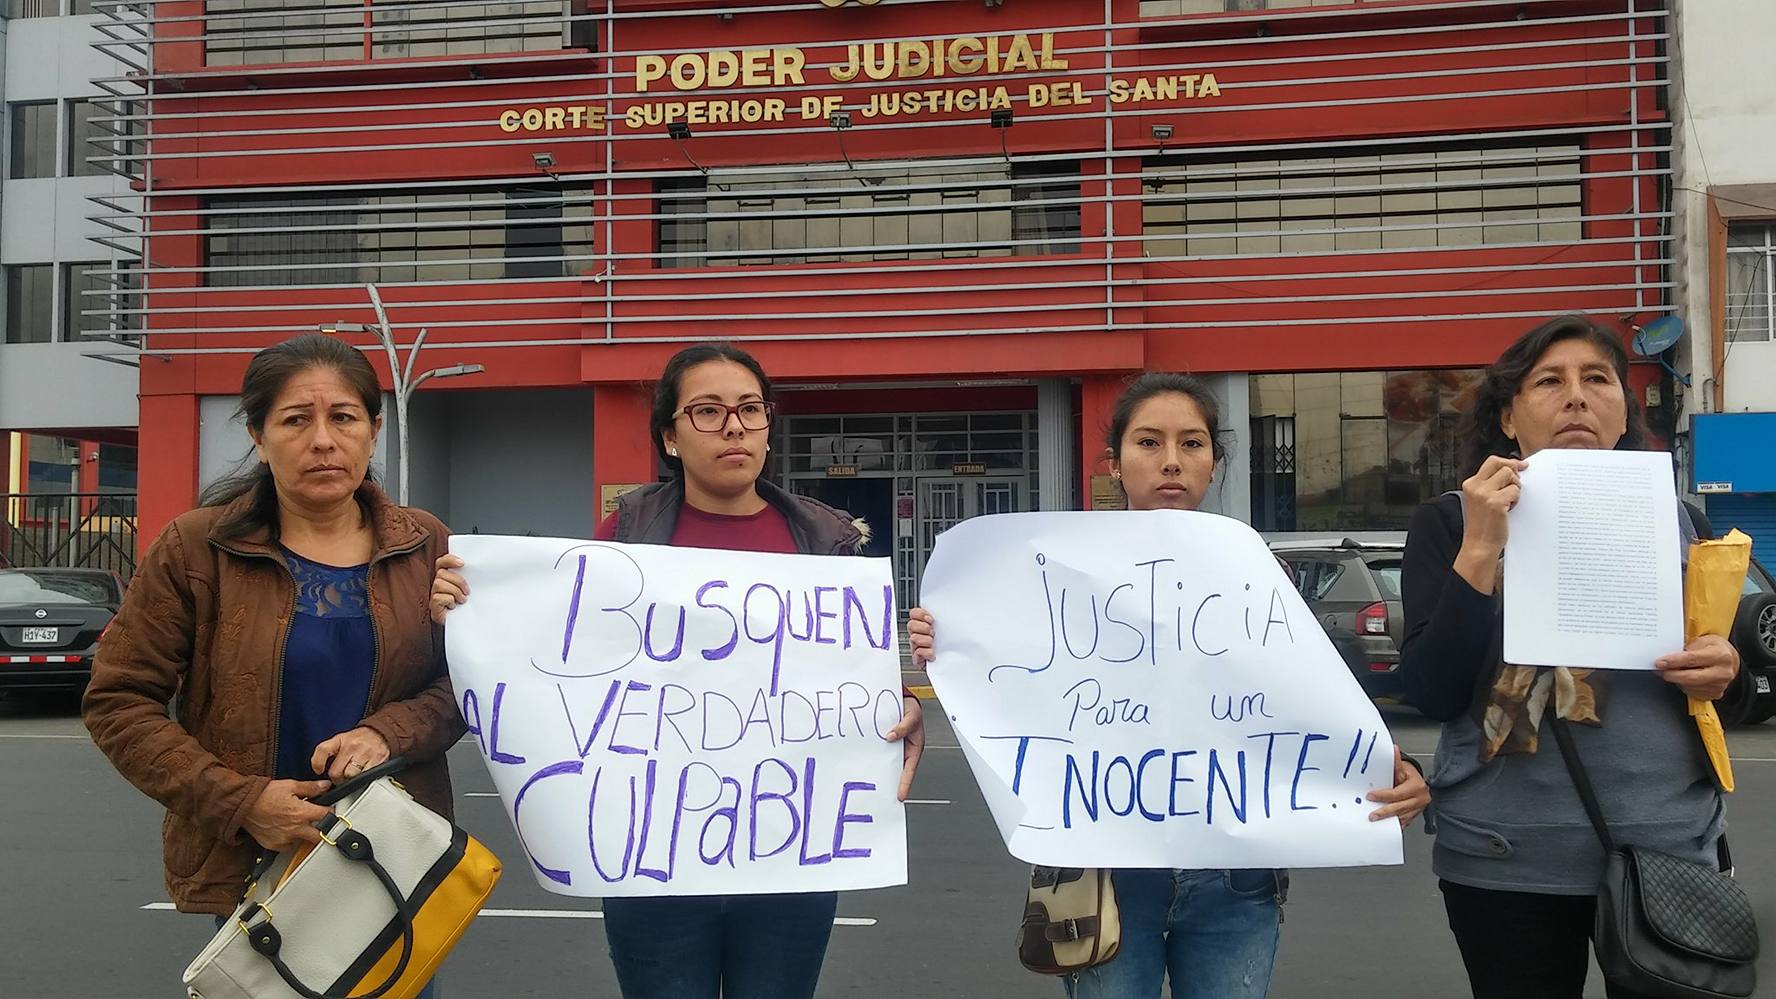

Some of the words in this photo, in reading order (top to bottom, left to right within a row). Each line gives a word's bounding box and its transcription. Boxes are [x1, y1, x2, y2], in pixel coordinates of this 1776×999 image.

[634, 48, 806, 93] PODER
[828, 33, 1069, 80] JUDICIAL
[499, 105, 606, 133] CORTE
[625, 98, 786, 129] SUPERIOR
[861, 86, 1013, 118] JUSTICIA
[1028, 81, 1093, 108] DEL
[1109, 73, 1222, 104] SANTA
[828, 467, 856, 476] SALIDA
[955, 465, 985, 474] ENTRADA
[463, 683, 526, 764] AL
[558, 679, 902, 758] VERDADERO
[1062, 678, 1152, 732] Para
[1211, 691, 1274, 721] un
